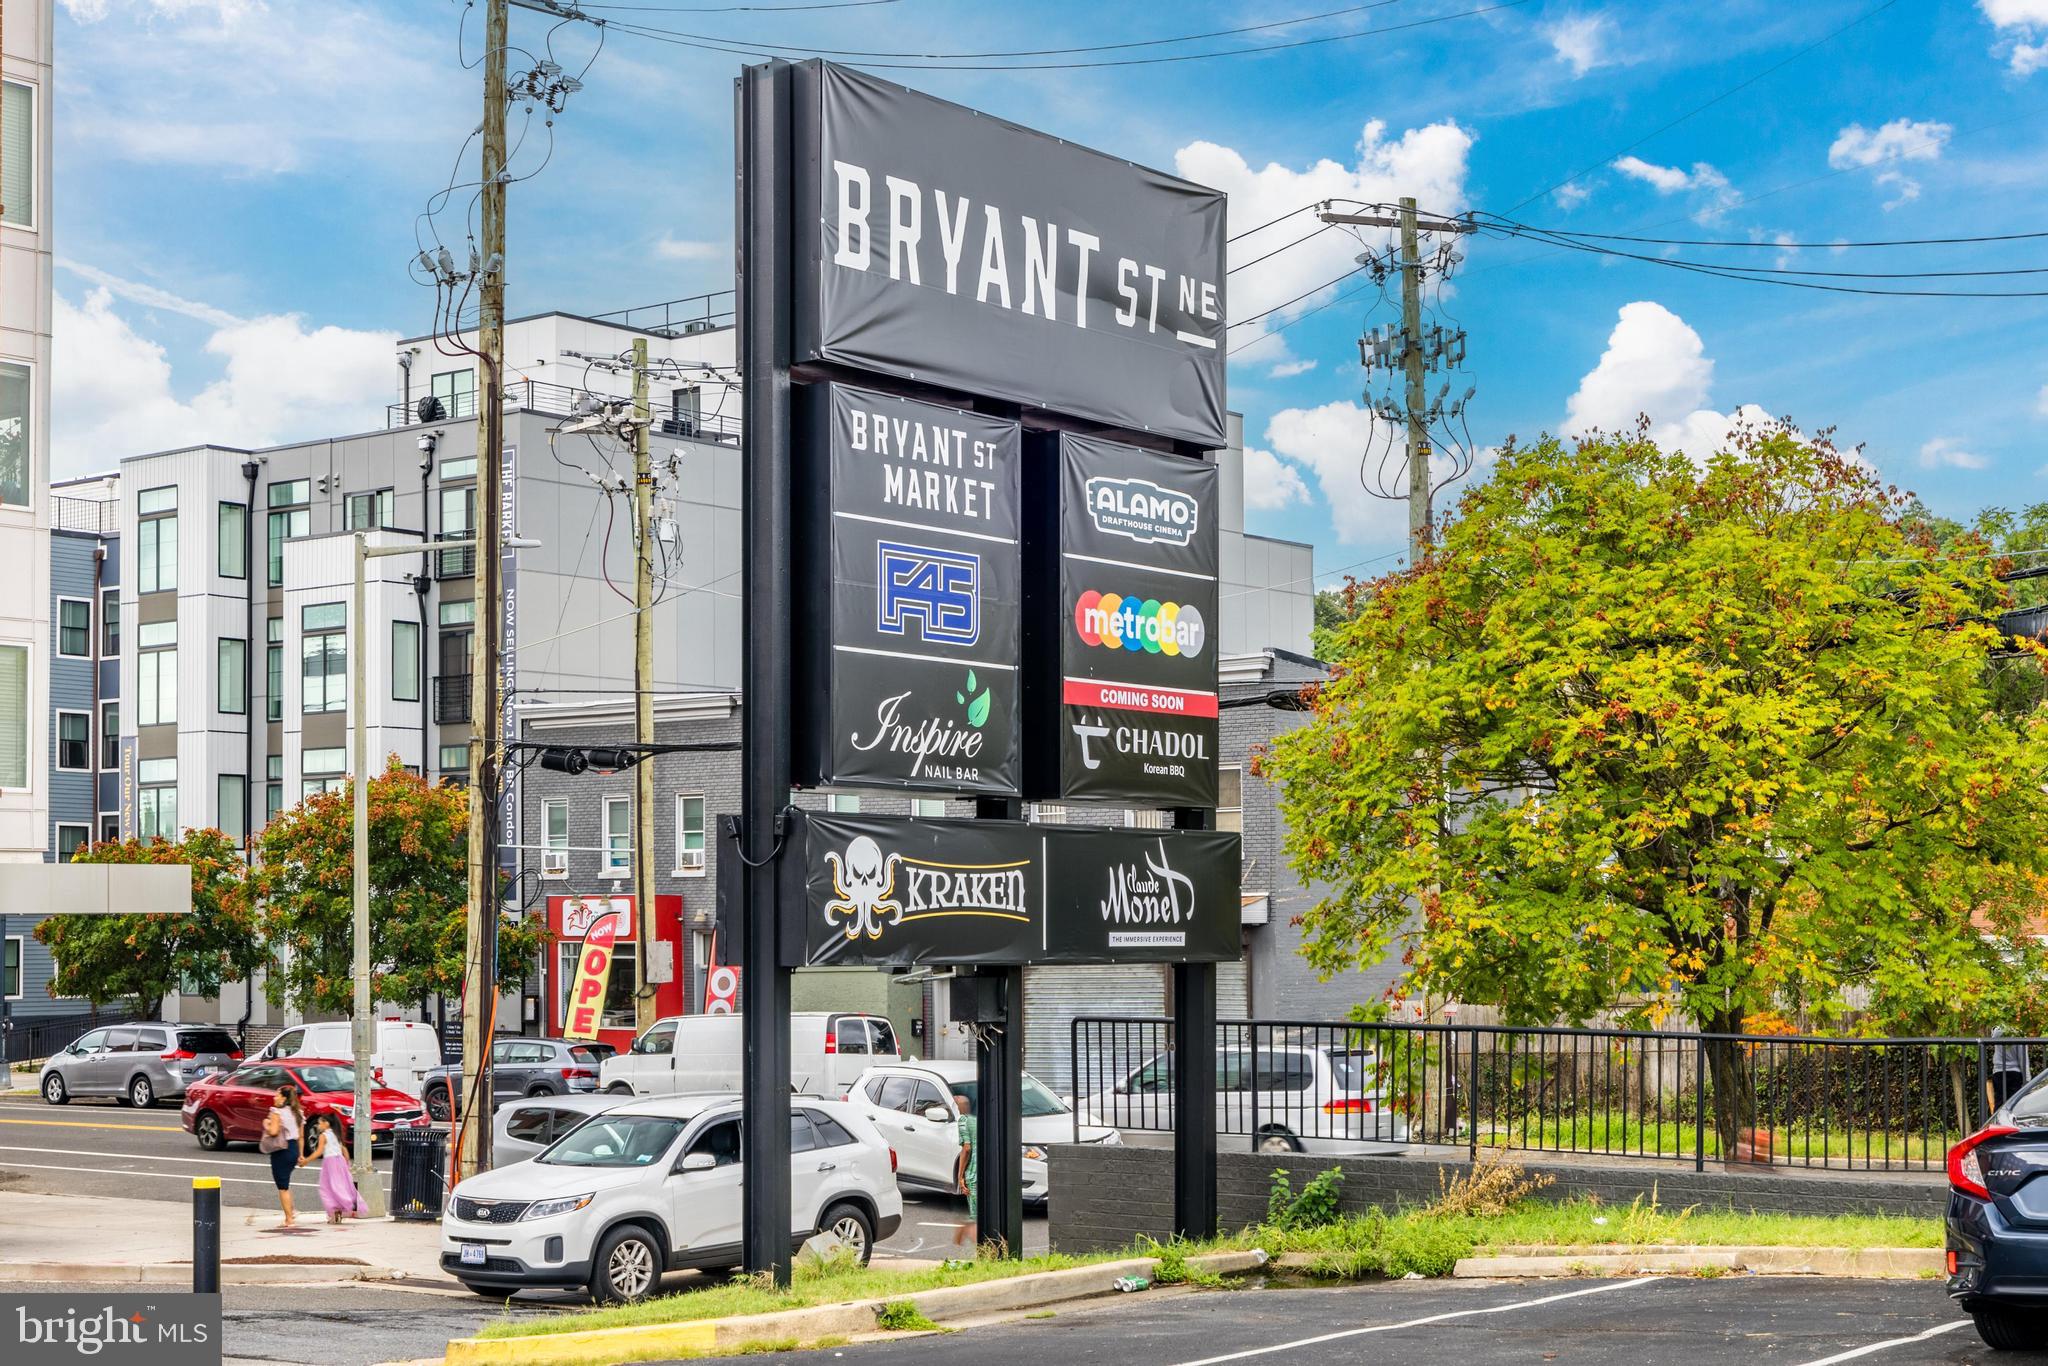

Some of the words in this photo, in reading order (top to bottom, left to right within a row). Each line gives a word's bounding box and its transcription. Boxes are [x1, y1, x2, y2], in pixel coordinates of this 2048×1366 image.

[834, 160, 1100, 329] BRYANT
[1115, 257, 1166, 333] ST
[1179, 275, 1217, 320] NE
[851, 409, 967, 469] BRYANT
[974, 440, 997, 470] ST
[884, 464, 995, 520] MARKET
[1096, 487, 1189, 524] ALAMO
[502, 492, 512, 541] BARKE
[1102, 515, 1153, 532] DRAFTHOUSE
[1154, 525, 1183, 537] CINEMA
[506, 589, 515, 626] NOW
[1084, 606, 1200, 647] metrobar
[506, 629, 515, 688] SELLING
[506, 696, 515, 728] New
[1100, 689, 1149, 707] COMING
[1152, 694, 1184, 710] SOON
[851, 690, 983, 777] Inspire
[1115, 726, 1210, 760] CHADOL
[925, 765, 952, 779] NAIL
[956, 767, 979, 780] BAR
[1143, 763, 1169, 775] Korean
[1169, 765, 1185, 777] BBQ
[506, 793, 515, 846] Condos
[905, 866, 1026, 913] KRAKEN
[1101, 837, 1195, 924] Monet
[590, 921, 613, 941] NOW
